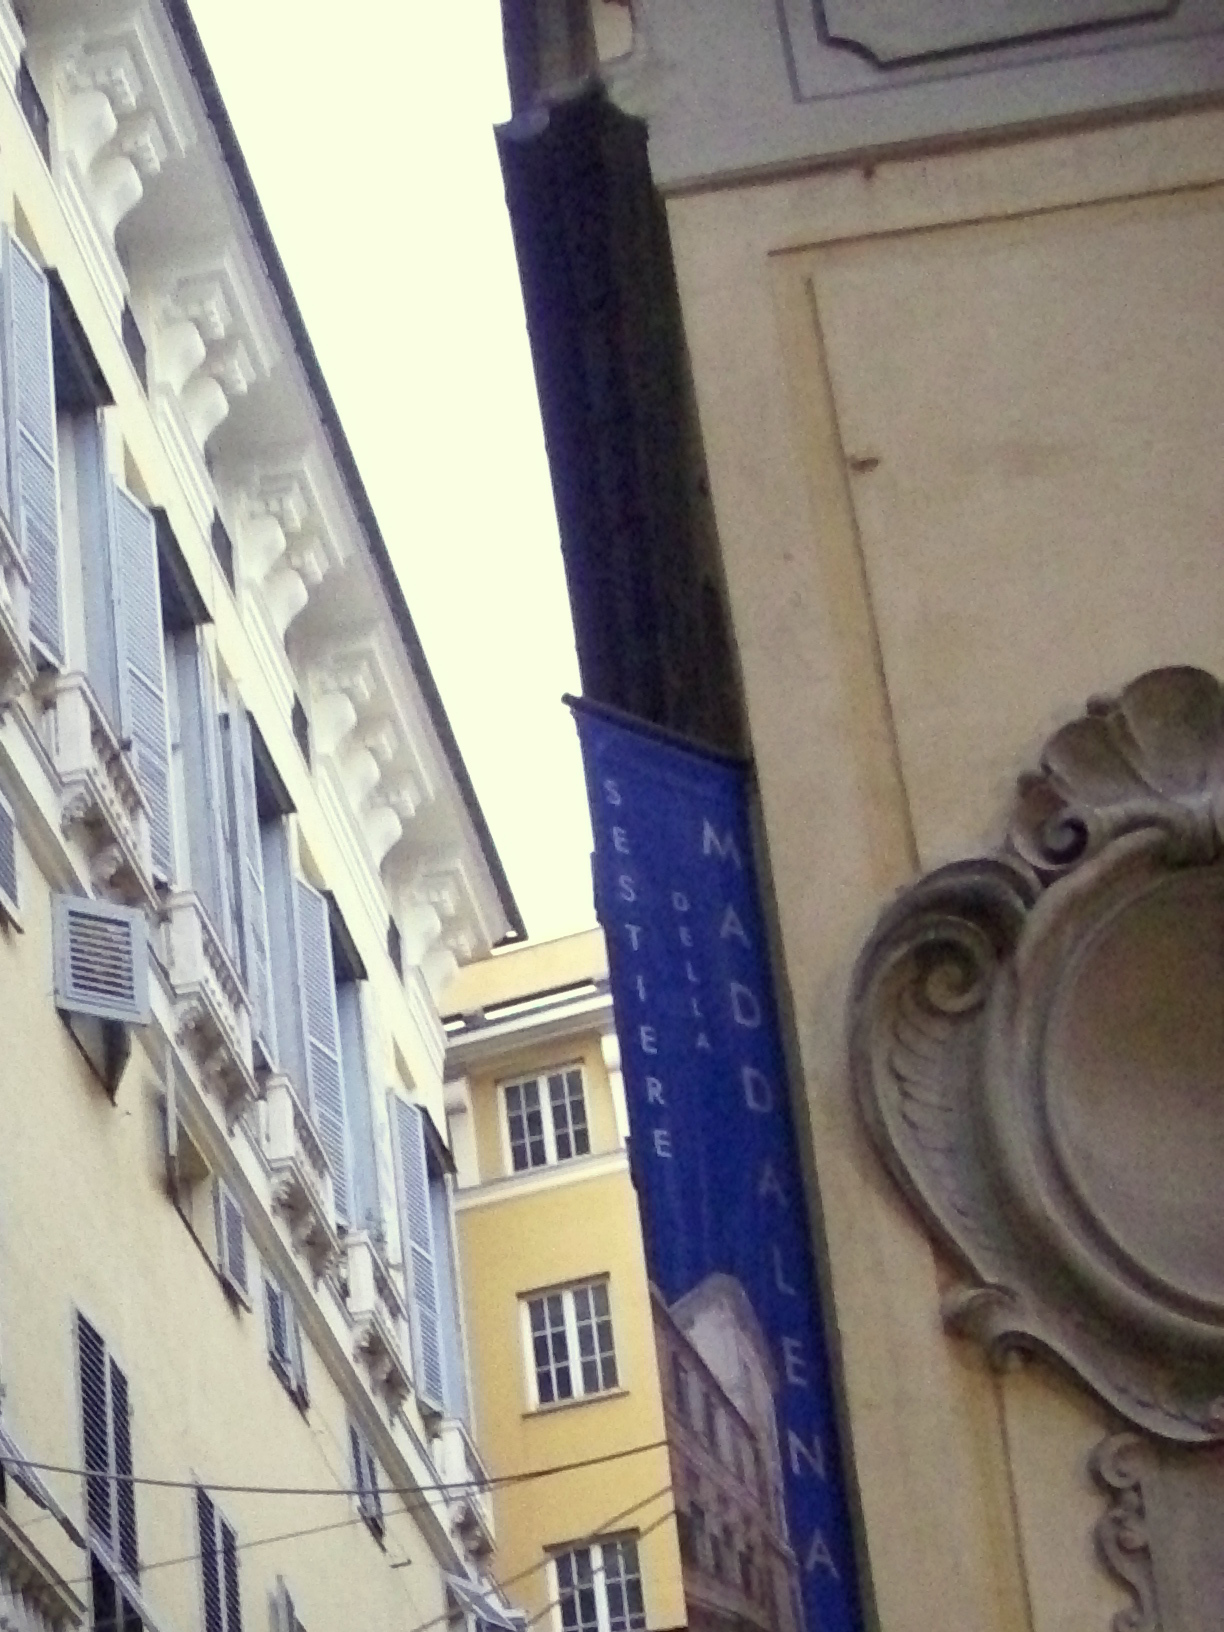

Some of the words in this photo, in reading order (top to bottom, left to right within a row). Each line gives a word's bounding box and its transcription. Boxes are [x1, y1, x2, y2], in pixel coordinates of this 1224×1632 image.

[603, 778, 673, 1159] SESTIERE
[672, 890, 711, 1050] DELLA
[701, 814, 842, 1580] MADDALENA
